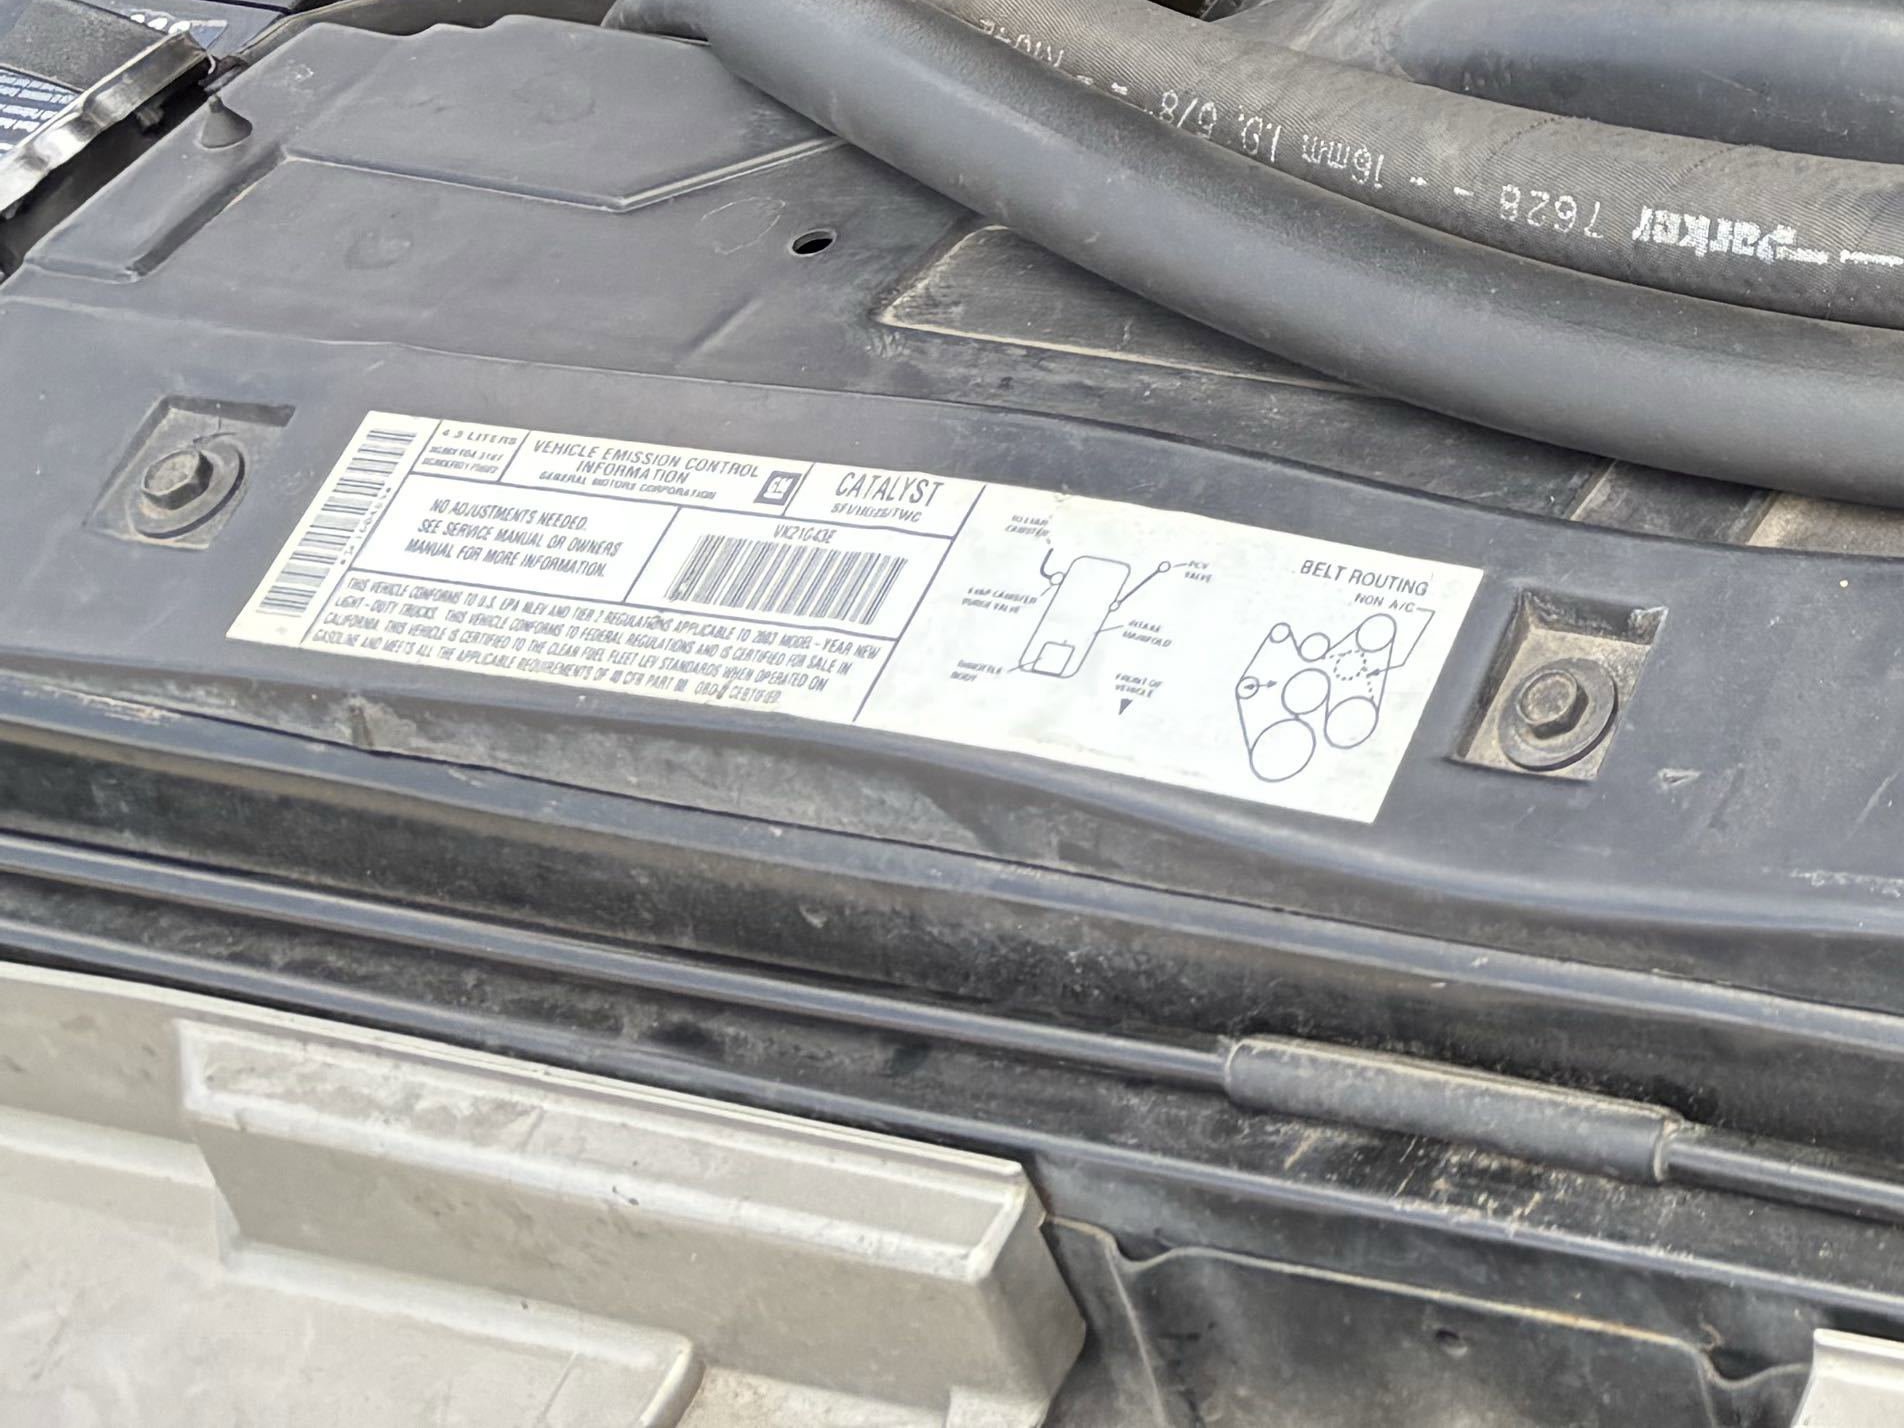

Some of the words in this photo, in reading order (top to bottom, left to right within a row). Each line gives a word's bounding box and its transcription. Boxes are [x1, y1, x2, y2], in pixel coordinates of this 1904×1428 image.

[1499, 183, 1603, 239] 7628
[532, 440, 600, 461] VEHICLE
[602, 445, 682, 468] EMISSION
[684, 455, 760, 479] CONTROL
[575, 460, 691, 485] INFORMATION
[833, 471, 945, 508] CATALYST
[429, 498, 447, 514] NO
[448, 500, 539, 525] ADJUSTMENTS
[403, 538, 460, 560] MANUAL
[456, 544, 481, 562] FOR
[482, 548, 521, 568] MORE
[417, 519, 443, 535] SEE
[444, 522, 492, 542] SERVICE
[495, 528, 546, 549] MANUAL
[547, 534, 568, 550] OR
[566, 537, 624, 559] OWNERS
[1299, 558, 1348, 582] BELT
[1347, 567, 1430, 597] ROUTING
[347, 576, 370, 591] THIS
[369, 580, 408, 598] VEHICLE
[407, 584, 465, 606] CONFORMS
[464, 591, 479, 607] TO
[673, 618, 736, 642] APPLICABLE
[736, 627, 751, 642] TO
[821, 638, 853, 656] YEAR
[852, 643, 882, 661] NEW
[1353, 592, 1386, 608] NON
[1388, 598, 1418, 615] A/C
[383, 619, 407, 635] THIS
[406, 622, 448, 642] VEHICLE
[458, 629, 513, 650] CERTIFIED
[545, 641, 580, 659] CLEAN
[609, 649, 637, 667] FLEET
[660, 656, 722, 679] STANDARDS
[721, 664, 753, 683] WHEN
[753, 668, 806, 690] OPERATED
[444, 609, 468, 624] THIS
[467, 611, 510, 631] VEHICLE
[509, 618, 567, 638] CONFORMS
[579, 627, 624, 645] FEDERAL
[625, 631, 695, 655] REGULATIONS
[695, 642, 720, 658] AND
[731, 646, 786, 667] CERTIFIED
[785, 653, 807, 669] FOR
[806, 656, 836, 674] SALE
